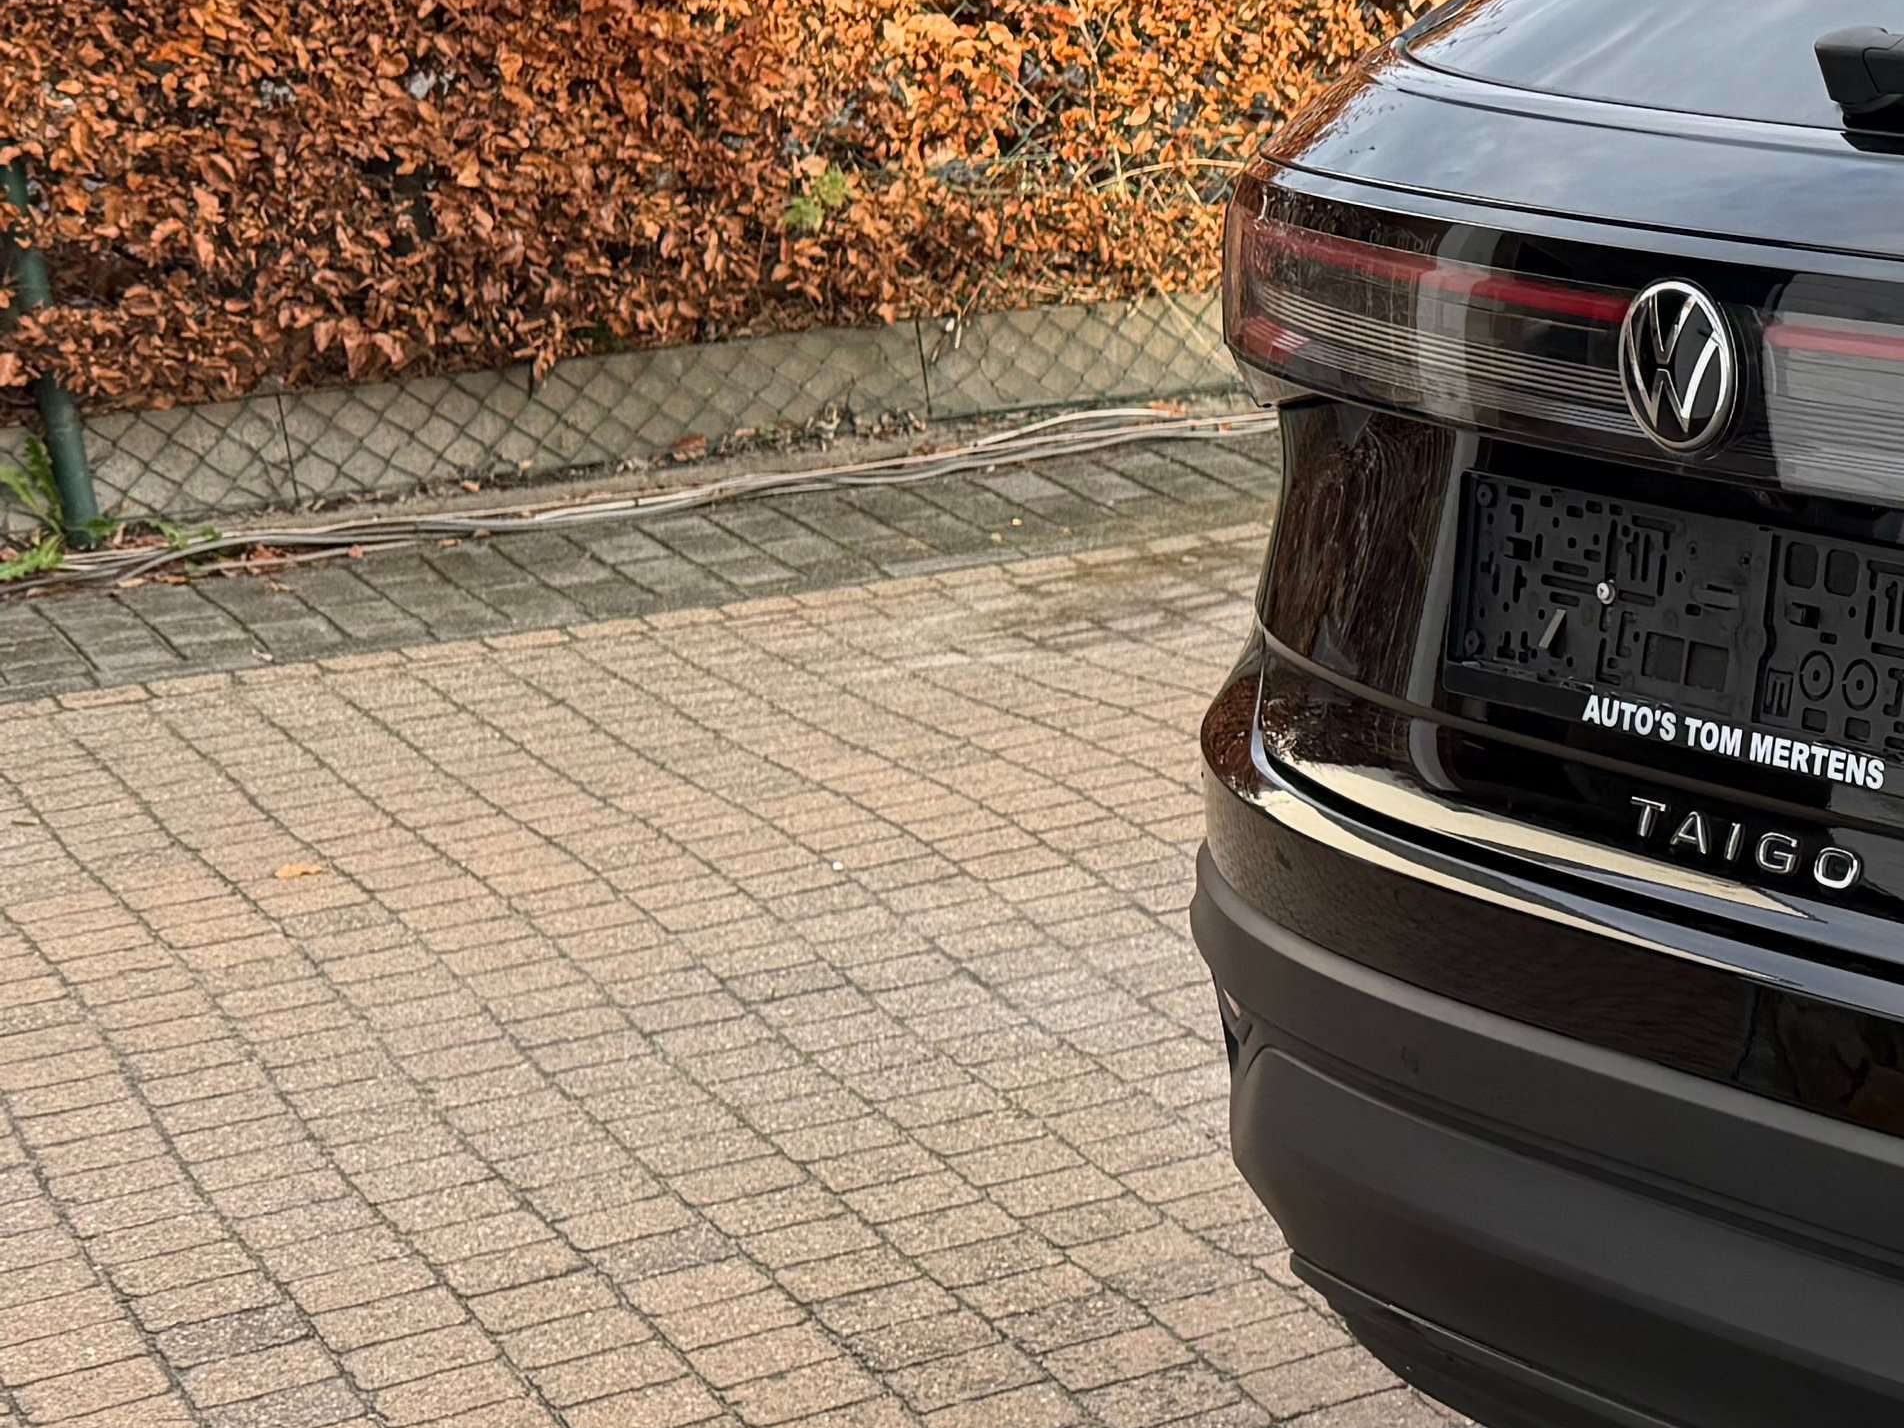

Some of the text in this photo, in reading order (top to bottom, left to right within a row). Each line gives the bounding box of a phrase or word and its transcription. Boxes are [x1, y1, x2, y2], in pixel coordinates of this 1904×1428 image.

[1582, 695, 1885, 790] AUTO'S TOM MERTENS
[1630, 795, 1862, 890] TAIGO
